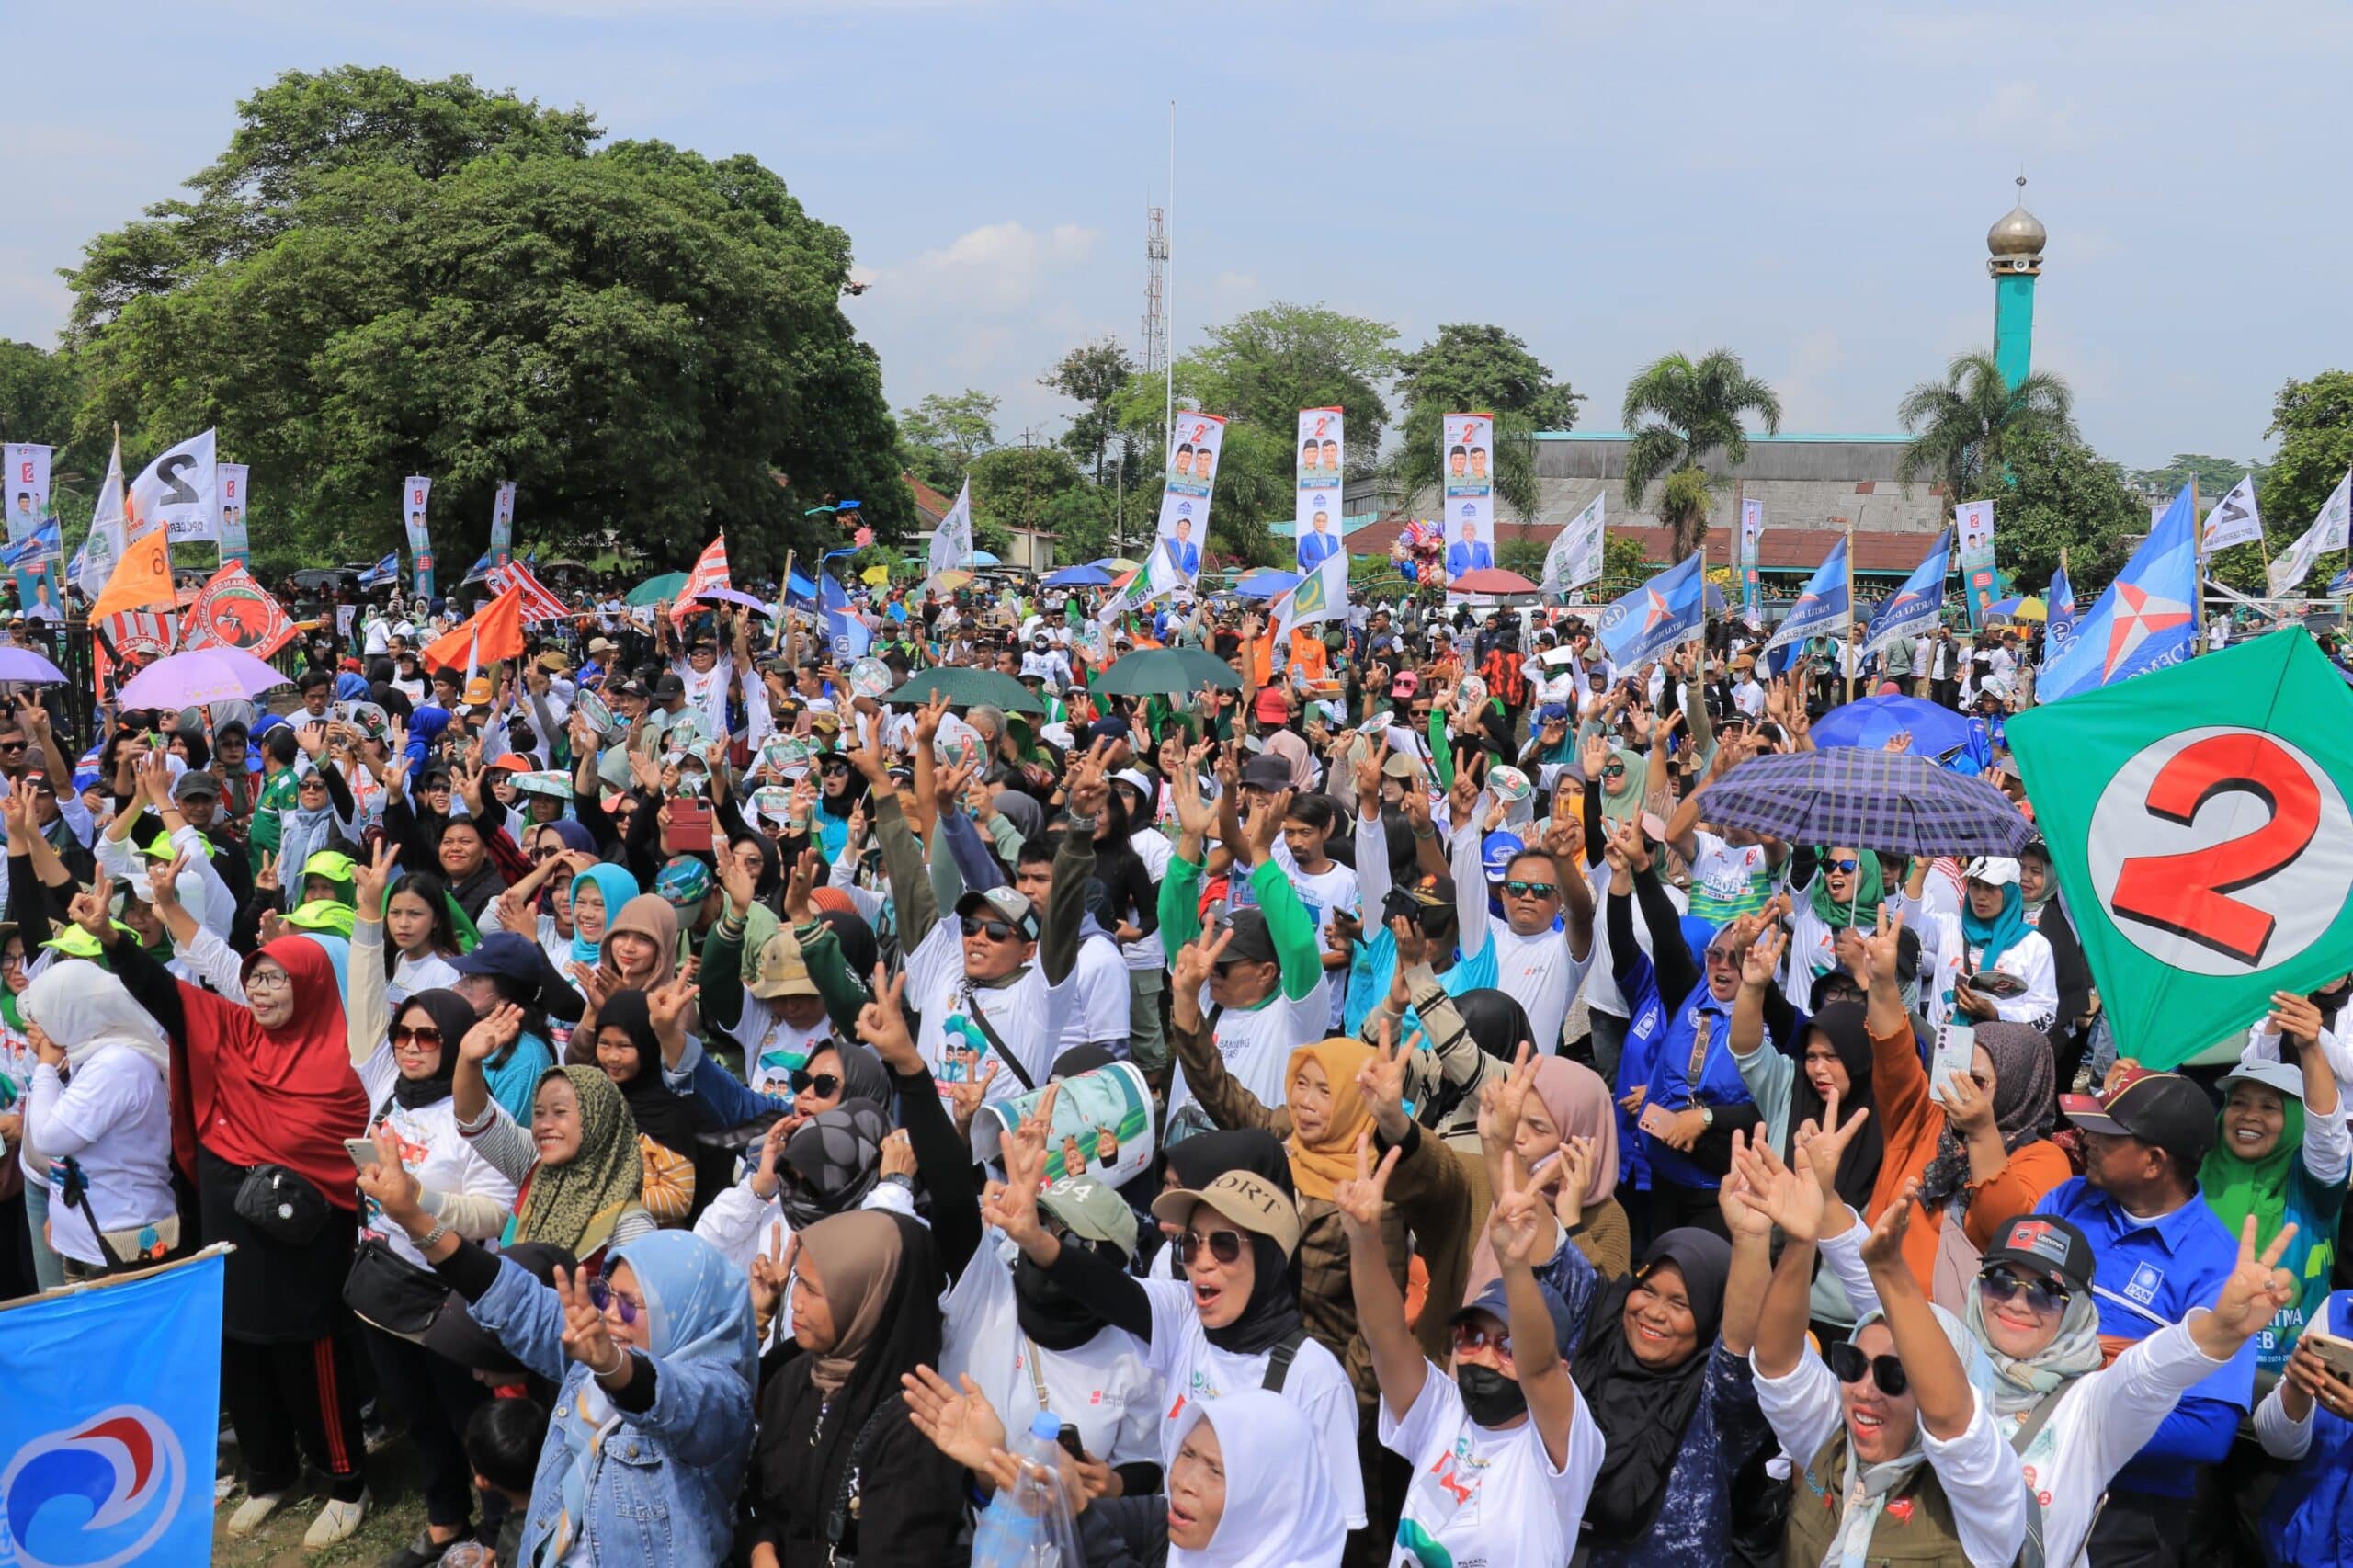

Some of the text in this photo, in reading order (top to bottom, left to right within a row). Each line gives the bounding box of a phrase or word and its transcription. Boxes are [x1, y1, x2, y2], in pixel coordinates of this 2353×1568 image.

[1191, 424, 1206, 443] 2
[1314, 417, 1325, 437] 2
[1462, 423, 1474, 442] 2
[2111, 733, 2322, 965] 2
[1214, 1176, 1281, 1214] ORT
[2037, 1233, 2066, 1251] Lenovo
[2127, 1285, 2152, 1301] PAN
